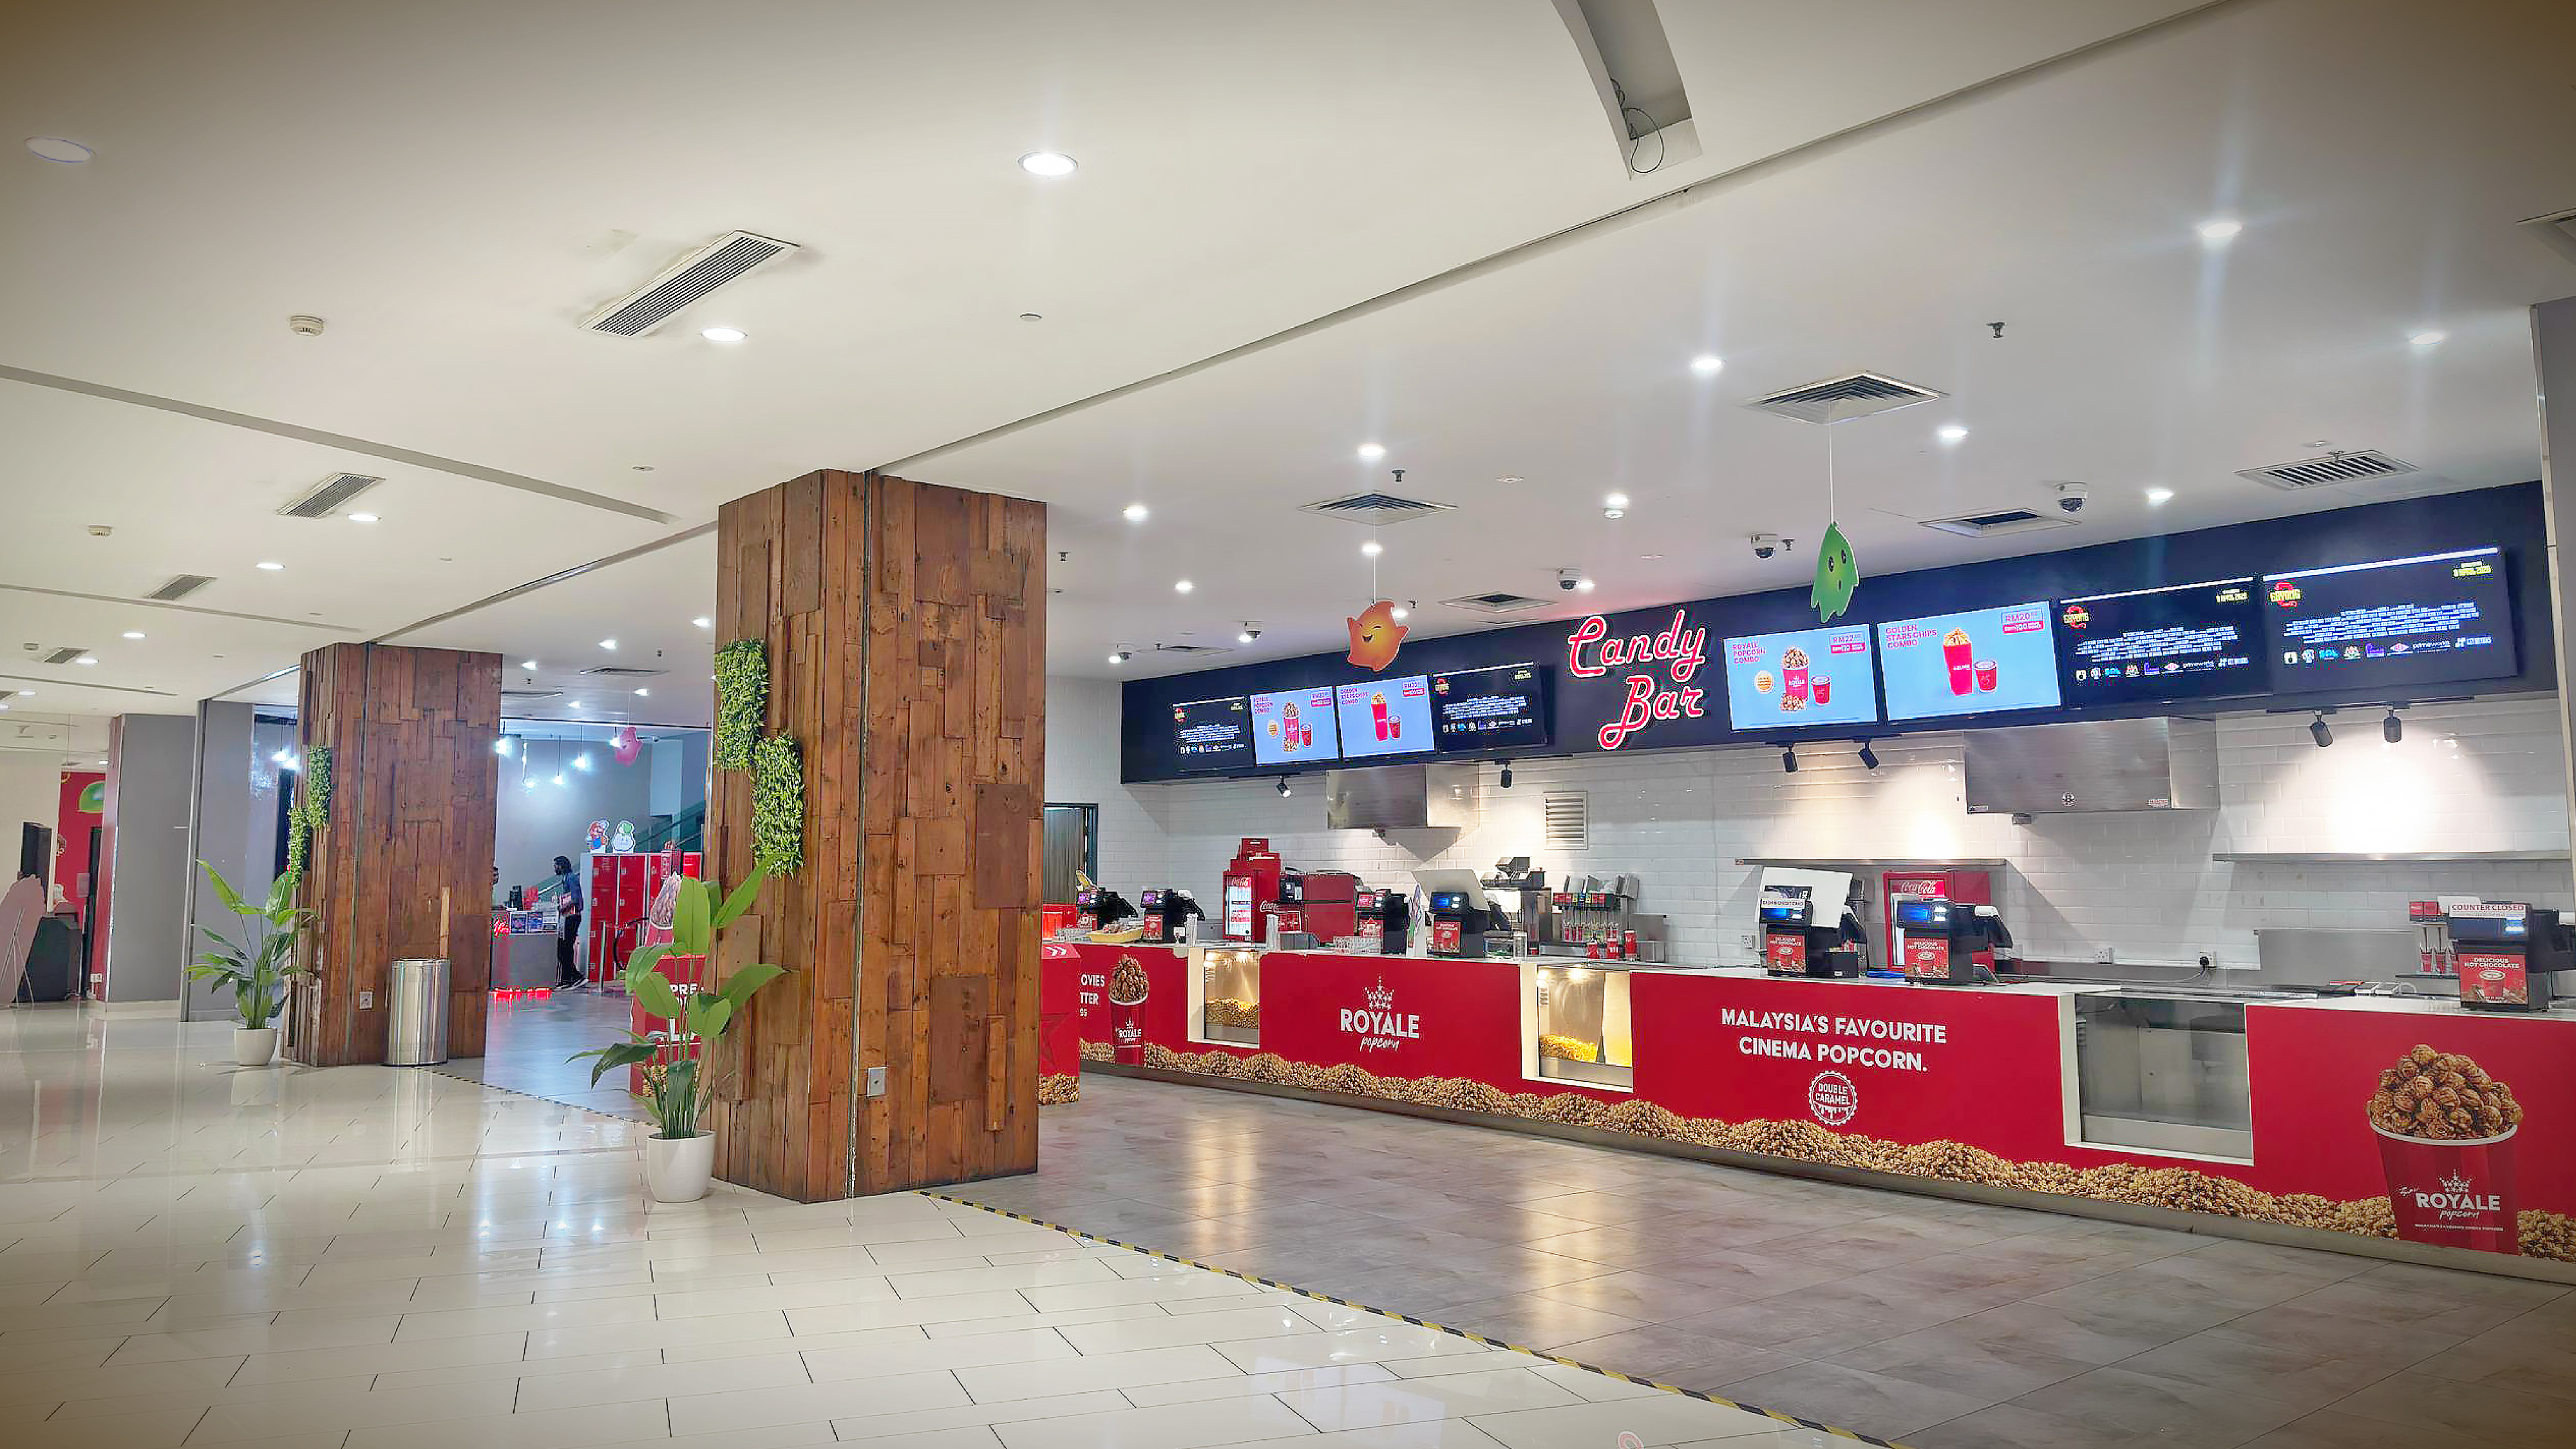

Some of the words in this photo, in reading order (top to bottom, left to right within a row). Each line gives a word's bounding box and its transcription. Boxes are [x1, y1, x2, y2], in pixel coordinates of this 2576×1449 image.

[1567, 609, 1705, 683] Candy
[1733, 647, 1766, 657] POPCORN
[1598, 674, 1705, 750] Bar
[1340, 1008, 1420, 1039] ROYALE
[1721, 1008, 1830, 1034] MALAYSIA'S
[1834, 1017, 1947, 1044] FAVOURITE
[1359, 1036, 1400, 1054] popcorn
[1739, 1036, 1812, 1061] CINEMA
[1817, 1043, 1928, 1072] POPCORN.
[1818, 1083, 1848, 1095] DOUBLE
[1815, 1092, 1851, 1106] CARAMEL
[2415, 1192, 2501, 1211] ROYALE
[2439, 1210, 2480, 1221] popcorn
